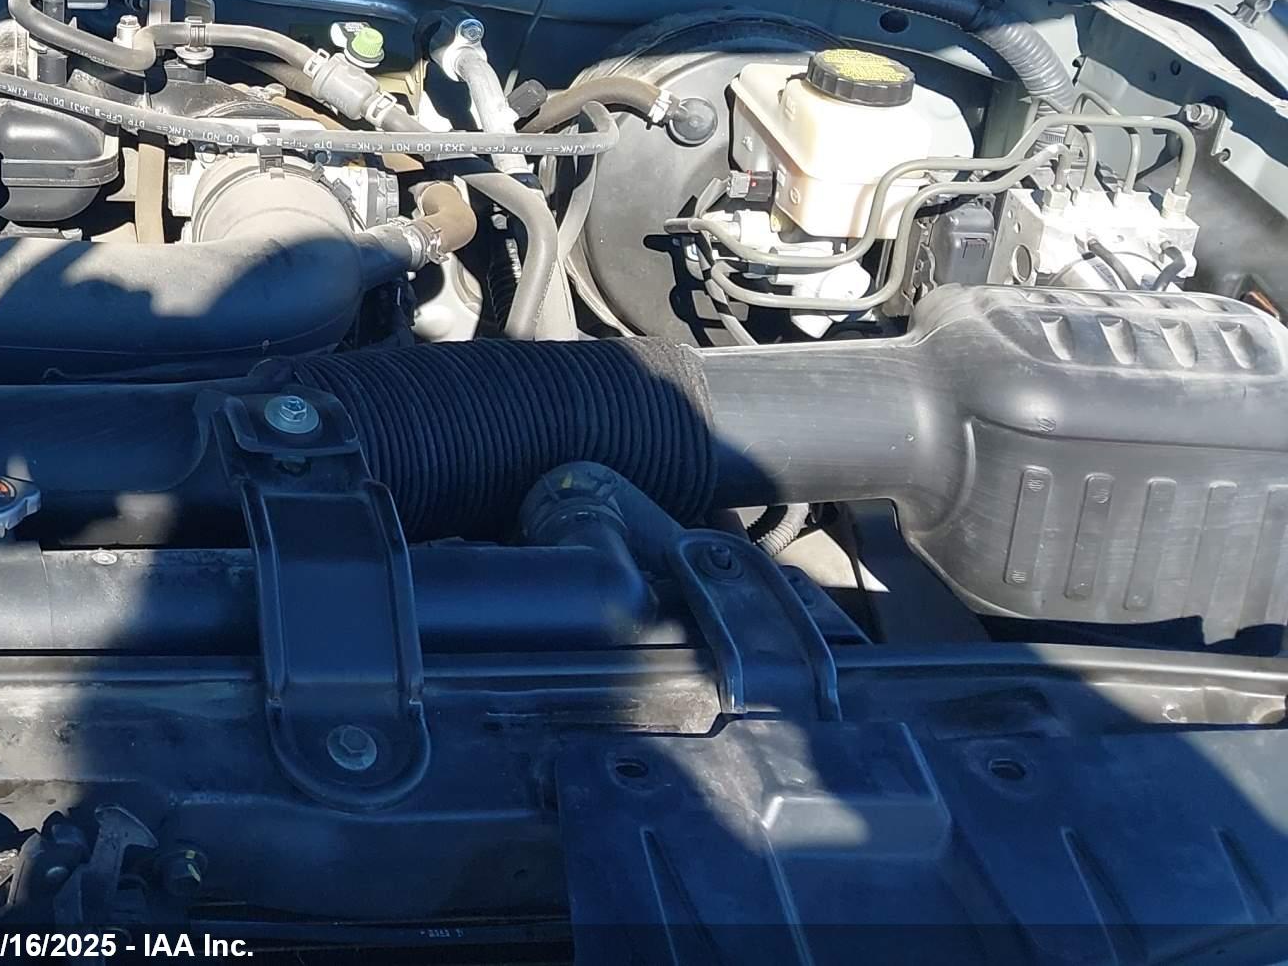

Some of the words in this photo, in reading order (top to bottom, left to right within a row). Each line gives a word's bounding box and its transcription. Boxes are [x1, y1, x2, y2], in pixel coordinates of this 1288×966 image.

[32, 92, 50, 103] NOT
[53, 97, 65, 107] DO
[69, 101, 91, 114] 3X31
[201, 130, 220, 141] NOT
[226, 133, 239, 143] DO
[390, 143, 410, 153] NOT
